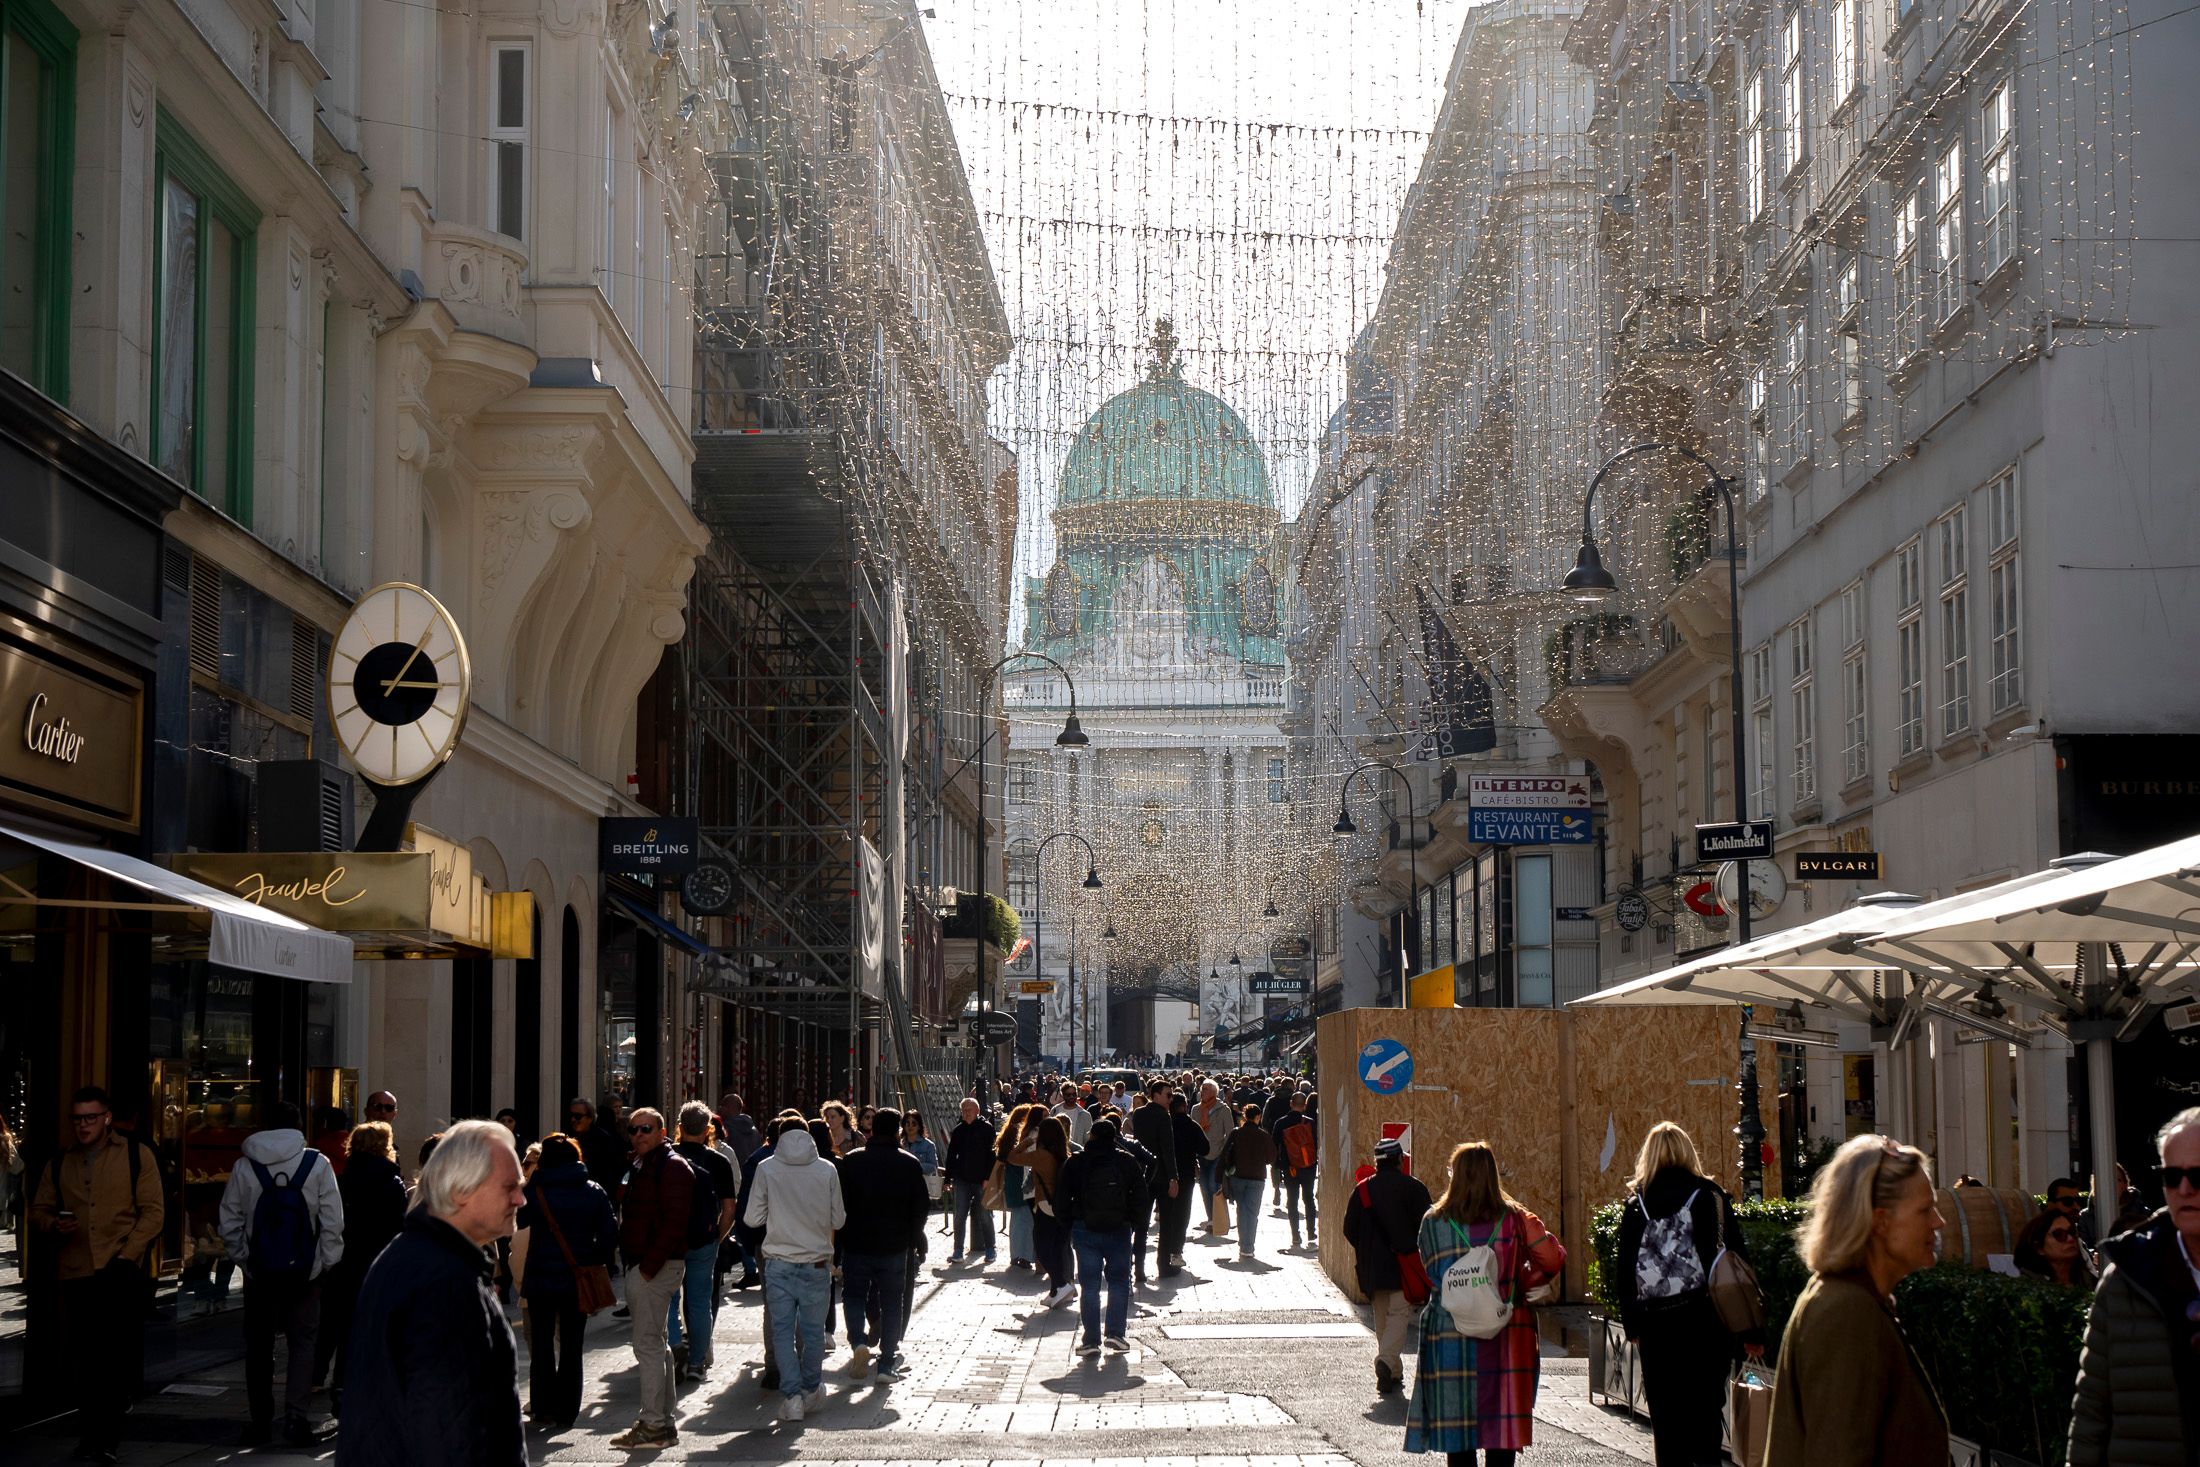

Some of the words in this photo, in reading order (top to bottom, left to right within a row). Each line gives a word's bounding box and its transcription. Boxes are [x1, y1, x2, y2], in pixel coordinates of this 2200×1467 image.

[27, 692, 84, 763] Cartier
[1493, 780, 1563, 790] TEMPO
[1474, 812, 1560, 823] RESTAURANT
[1474, 824, 1560, 840] LEVANTE
[613, 844, 689, 854] BREITLING
[640, 856, 661, 864] 1884
[1800, 861, 1875, 871] BVLGARI
[235, 866, 367, 906] Juwel
[1619, 902, 1644, 913] Tabak
[1619, 914, 1644, 924] Trafik
[1447, 1278, 1469, 1291] your
